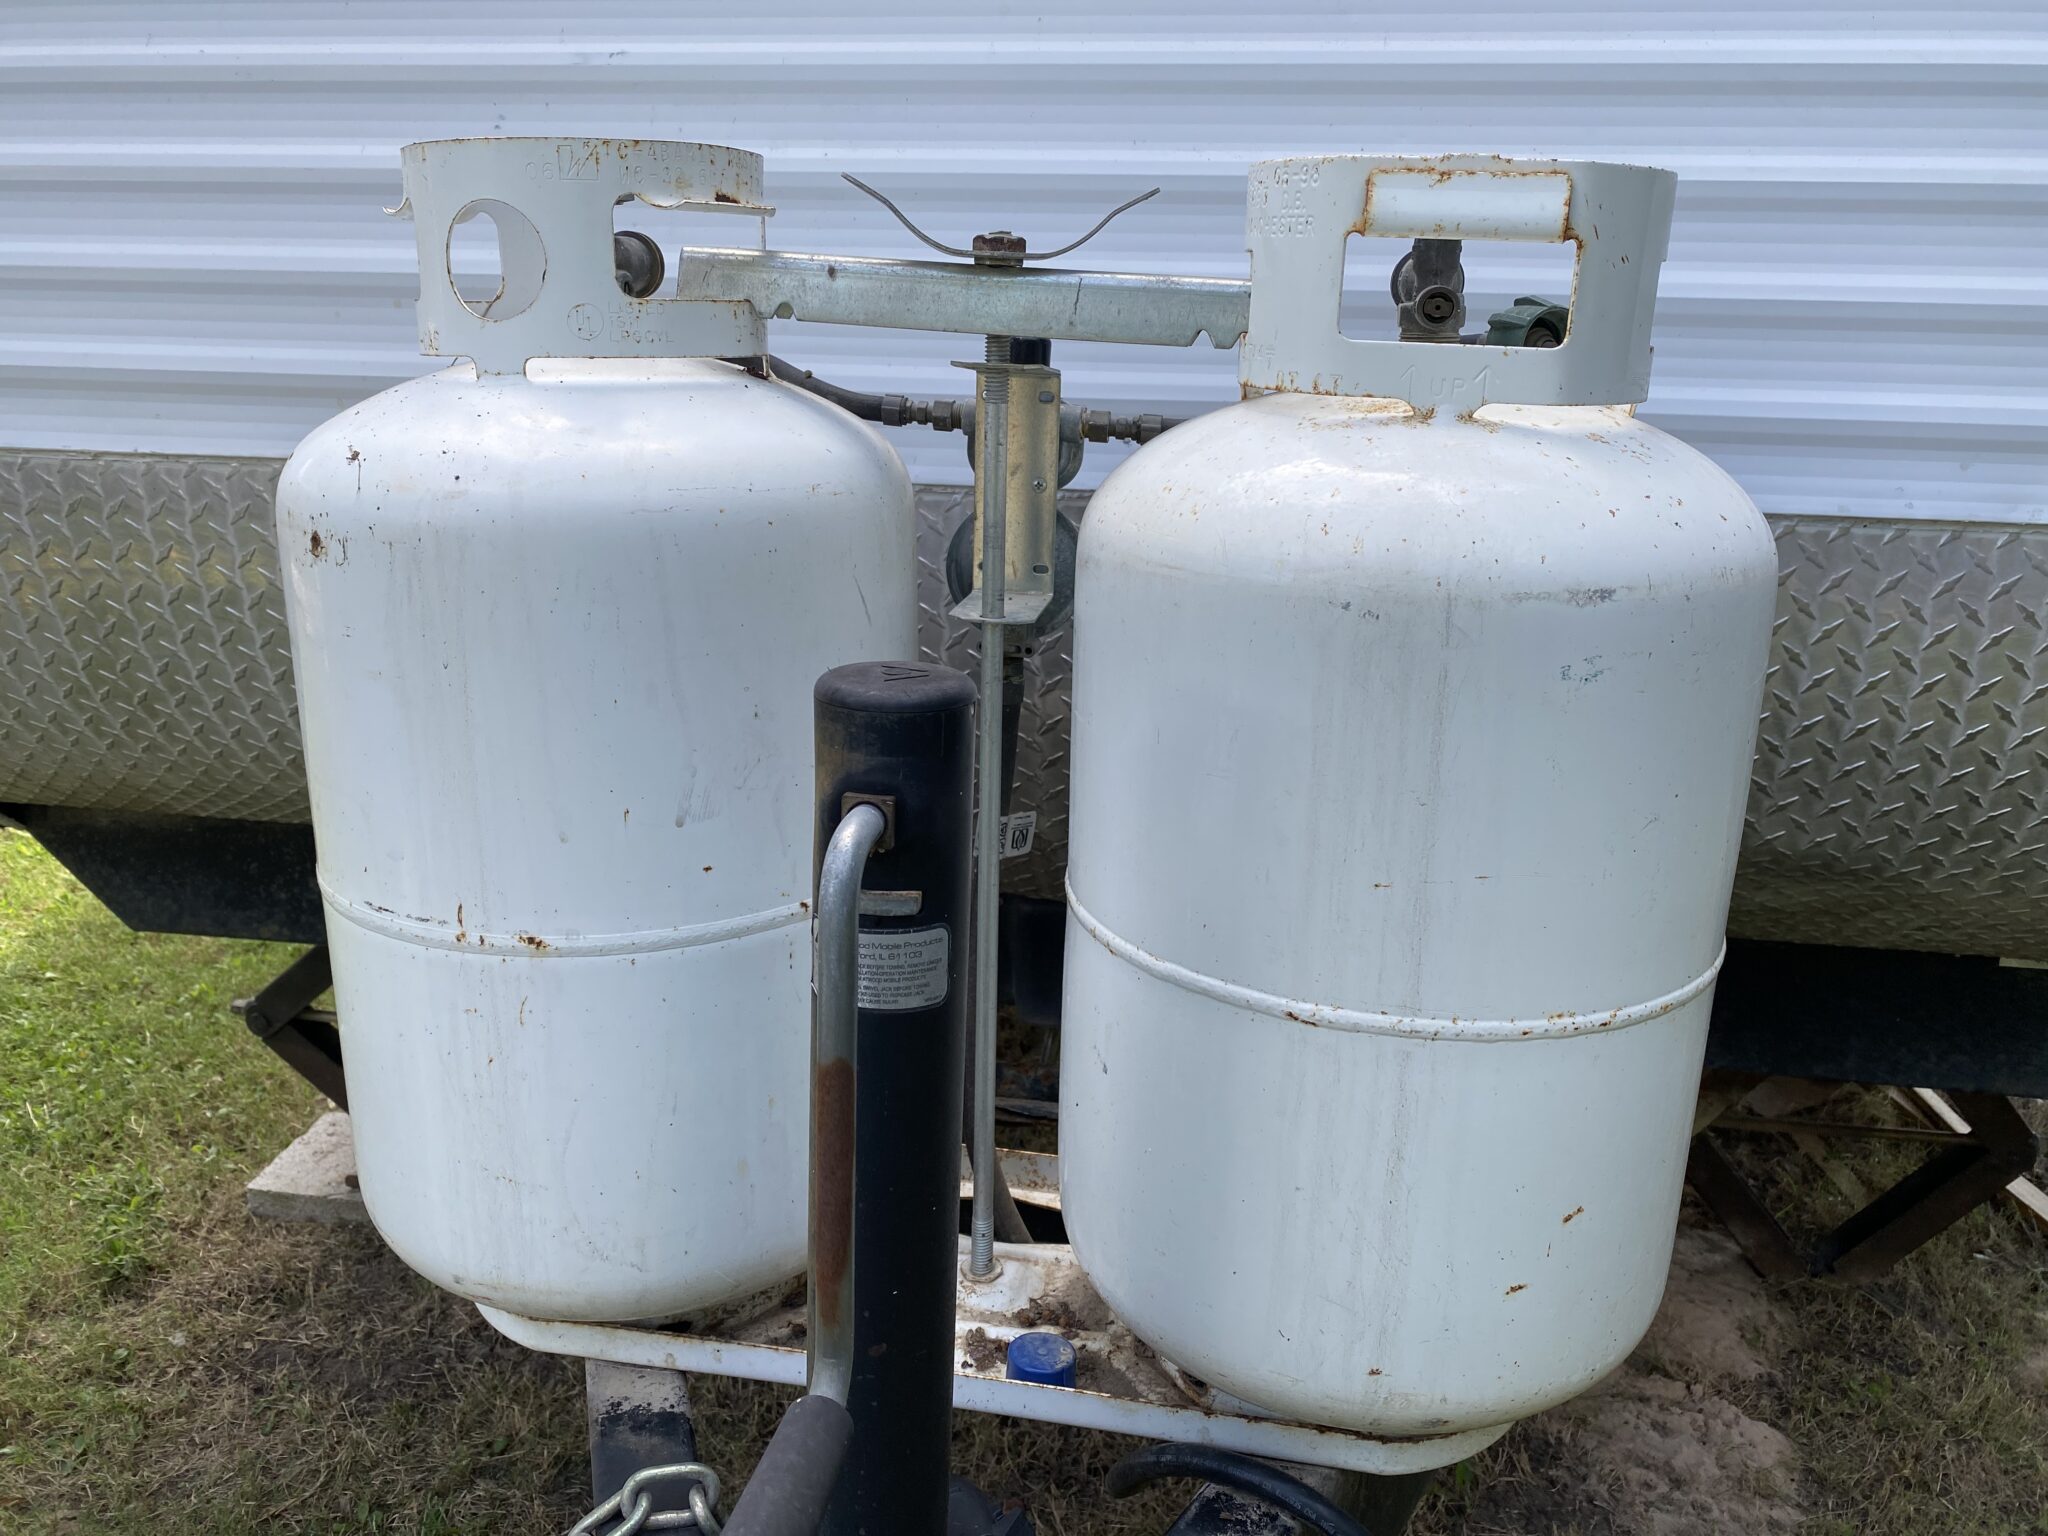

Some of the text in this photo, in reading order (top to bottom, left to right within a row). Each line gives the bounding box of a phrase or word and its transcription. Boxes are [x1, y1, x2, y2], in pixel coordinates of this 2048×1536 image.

[871, 942, 903, 950] Mobile
[903, 937, 944, 949] Products
[858, 950, 923, 961] ord, IL 61103
